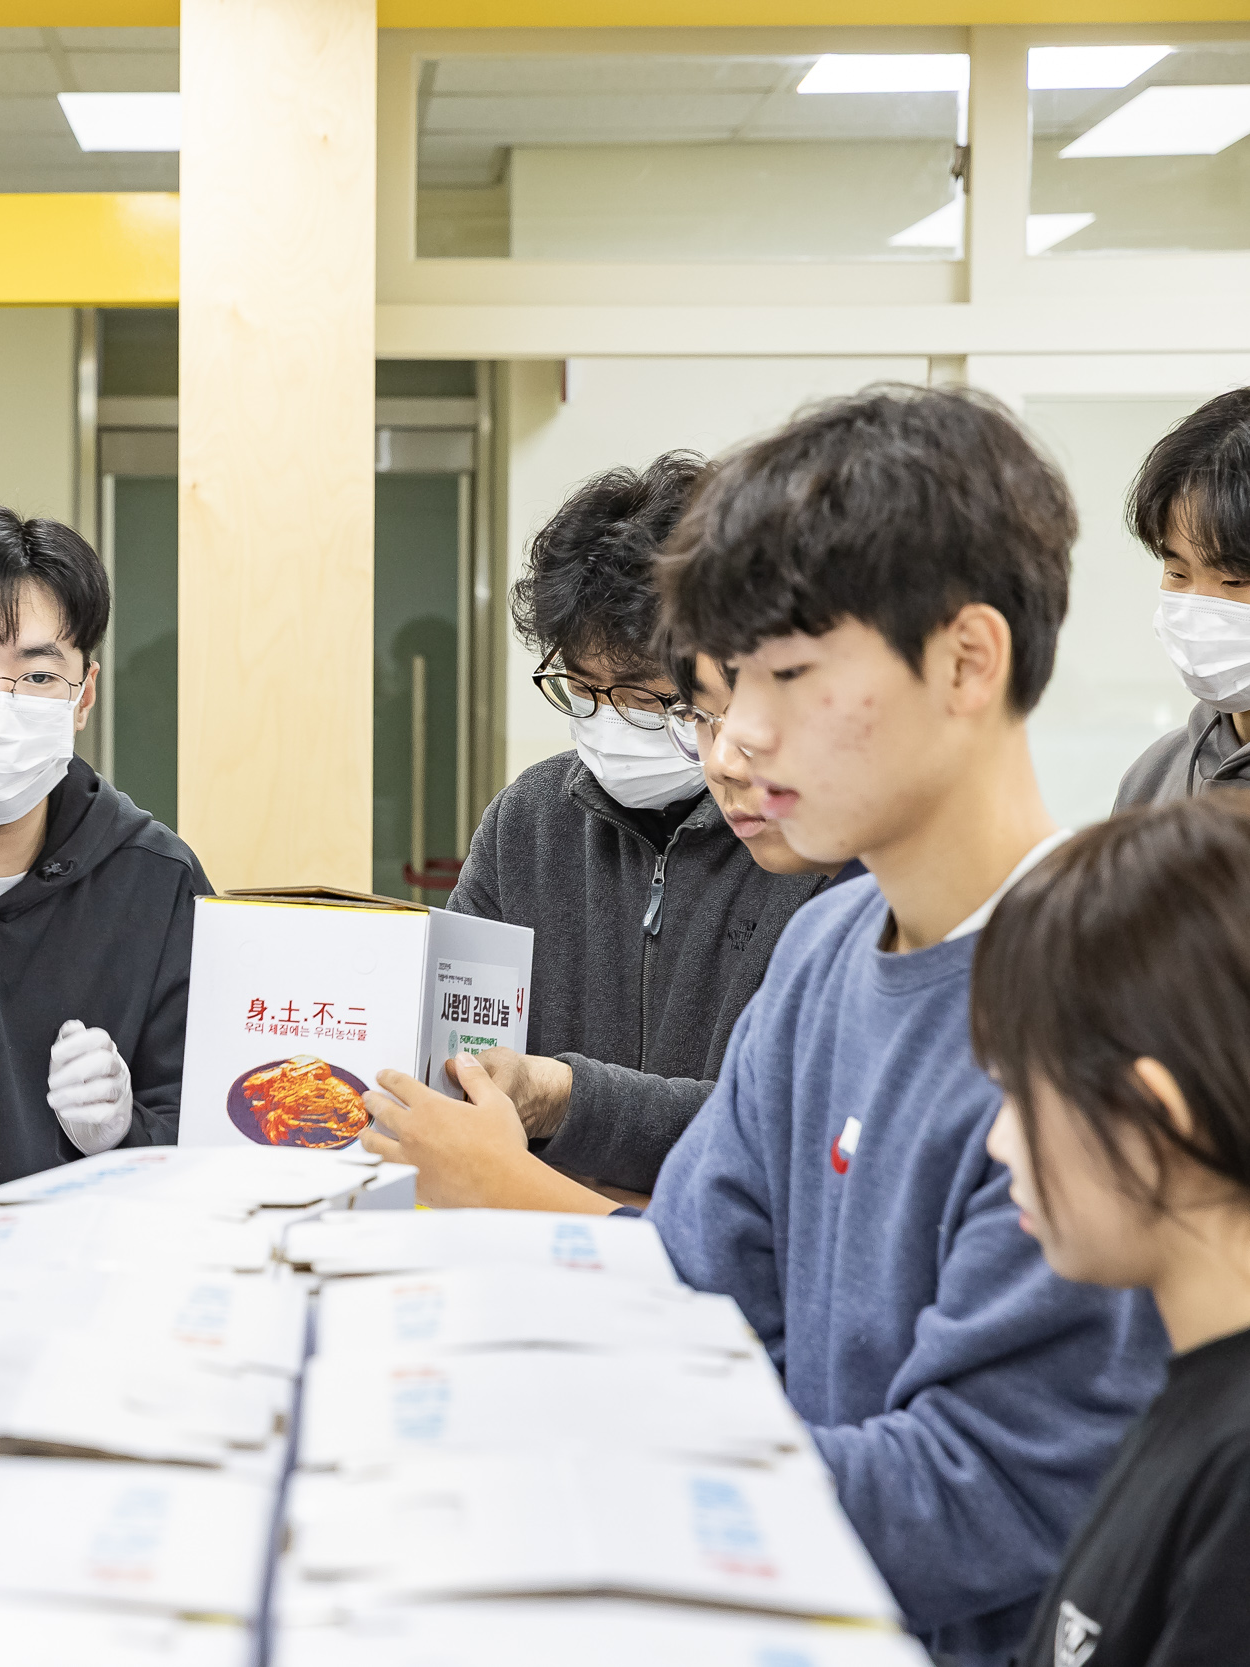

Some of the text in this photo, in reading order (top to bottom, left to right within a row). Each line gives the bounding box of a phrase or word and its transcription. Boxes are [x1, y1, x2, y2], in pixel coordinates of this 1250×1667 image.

[440, 992, 471, 1023] 사랑의
[473, 996, 510, 1027] 김장나눔
[244, 1021, 367, 1041] 우리 체질에는 우리농산물
